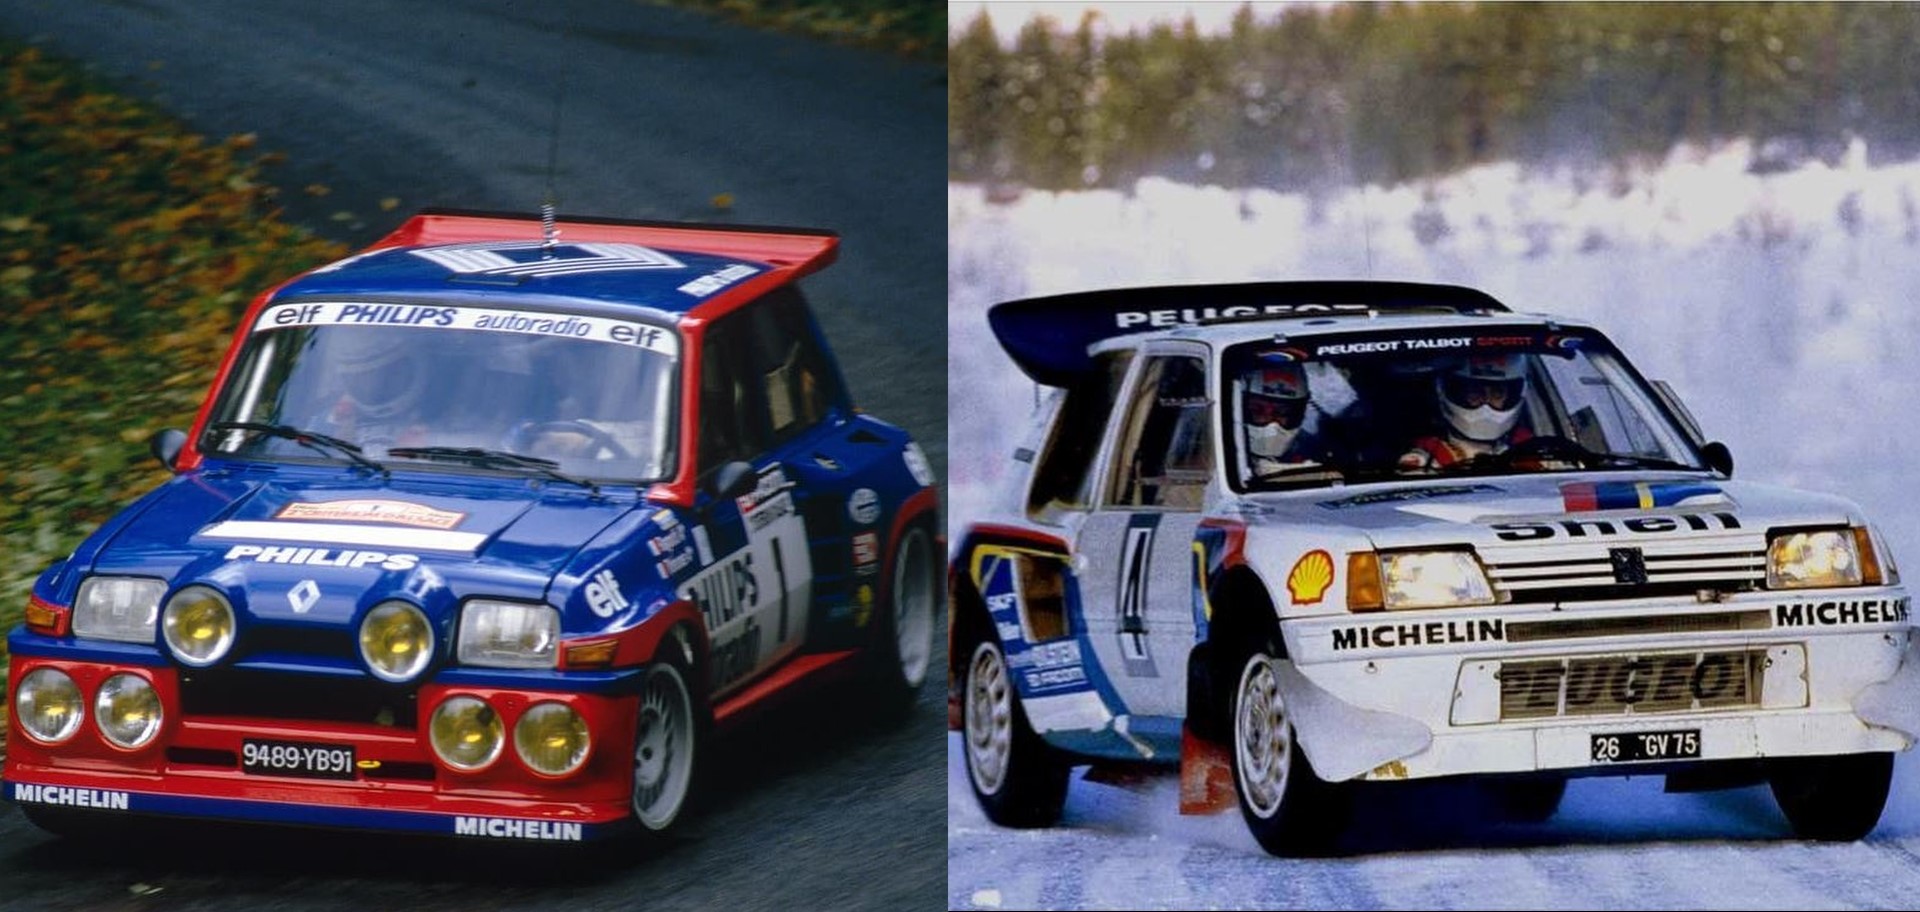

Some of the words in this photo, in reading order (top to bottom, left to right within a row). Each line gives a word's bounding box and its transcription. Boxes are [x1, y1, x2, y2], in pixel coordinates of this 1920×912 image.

[274, 304, 321, 325] elf
[336, 303, 458, 326] PHILIPS
[473, 311, 591, 338] autoradio
[609, 320, 661, 348] elf
[1317, 339, 1399, 356] PEUGEOT
[1404, 337, 1473, 351] TALBOT
[1491, 512, 1741, 540] Shell
[224, 545, 420, 571] PHILIPS
[585, 569, 630, 618] elf
[769, 537, 789, 644] 1
[1122, 531, 1147, 657] 4
[1332, 619, 1504, 650] MICHELIN
[242, 742, 353, 773] 9489-YB91
[1596, 736, 1620, 759] 26
[1673, 733, 1697, 755] 75
[14, 783, 129, 810] MICHELIN
[454, 816, 583, 841] MICHELIN
